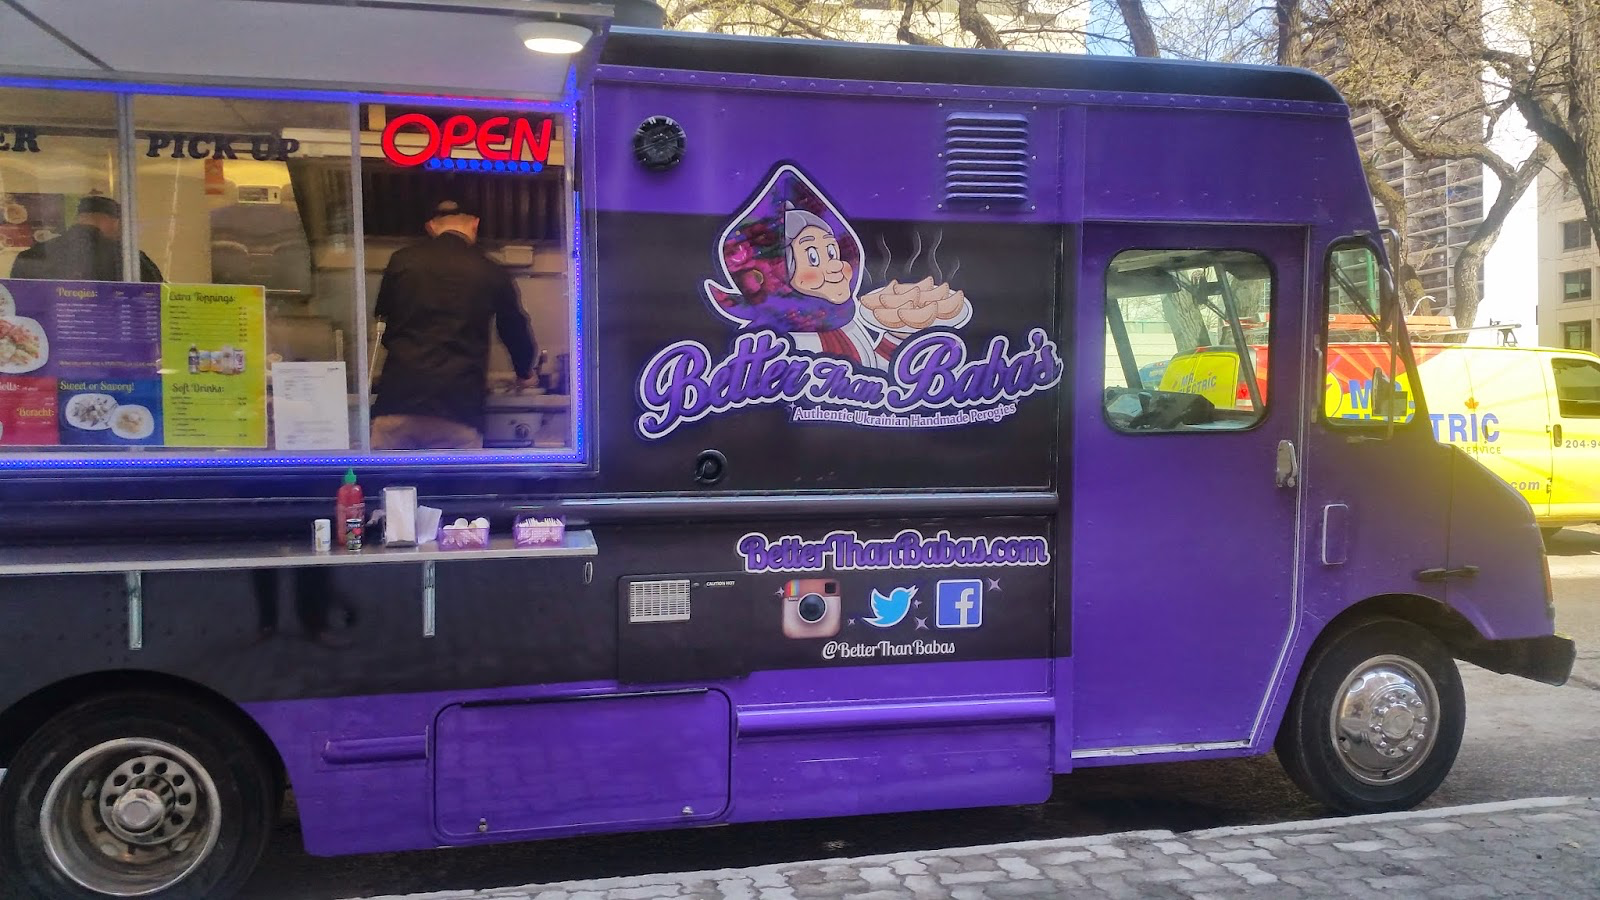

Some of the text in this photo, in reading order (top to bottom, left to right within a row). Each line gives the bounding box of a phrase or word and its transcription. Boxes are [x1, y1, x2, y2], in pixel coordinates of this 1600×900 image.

[146, 133, 299, 161] PICK UP
[382, 113, 552, 167] OPEN
[641, 329, 1062, 437] Better Than Baba's
[793, 403, 1017, 427] Authentic Ukrainian Handmade Perogies
[738, 530, 1050, 572] BetterThanBabas.com
[822, 639, 956, 660] @BetterThanBabas
